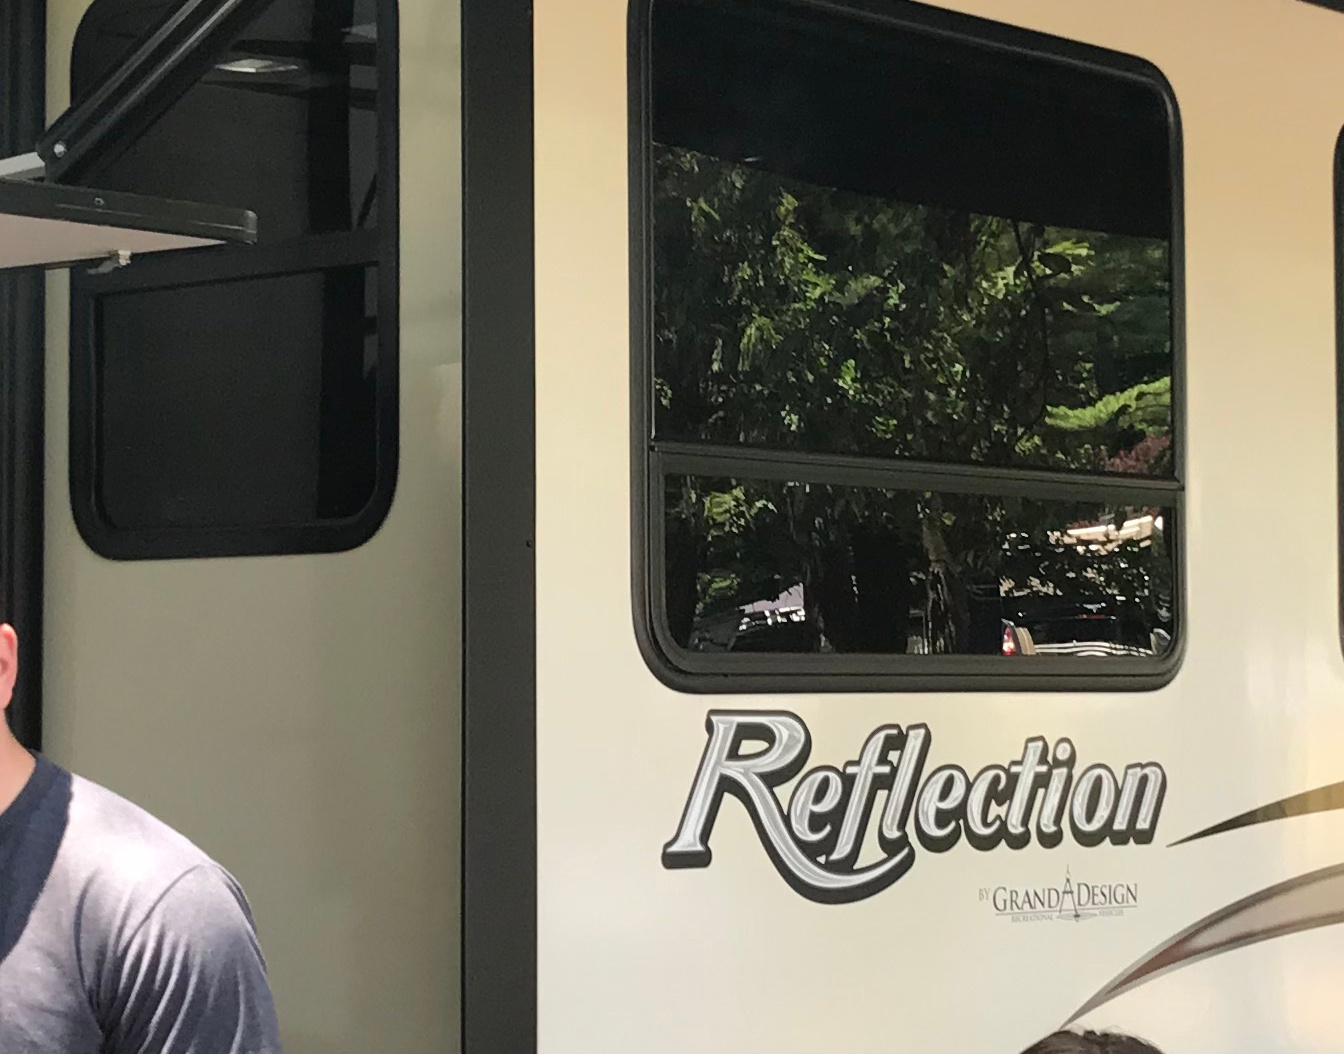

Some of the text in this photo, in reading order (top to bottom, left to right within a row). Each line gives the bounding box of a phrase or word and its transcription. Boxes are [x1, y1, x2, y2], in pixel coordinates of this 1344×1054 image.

[661, 709, 1167, 905] Reflection
[993, 886, 1059, 912] GRAND
[1077, 882, 1138, 907] DESIGN
